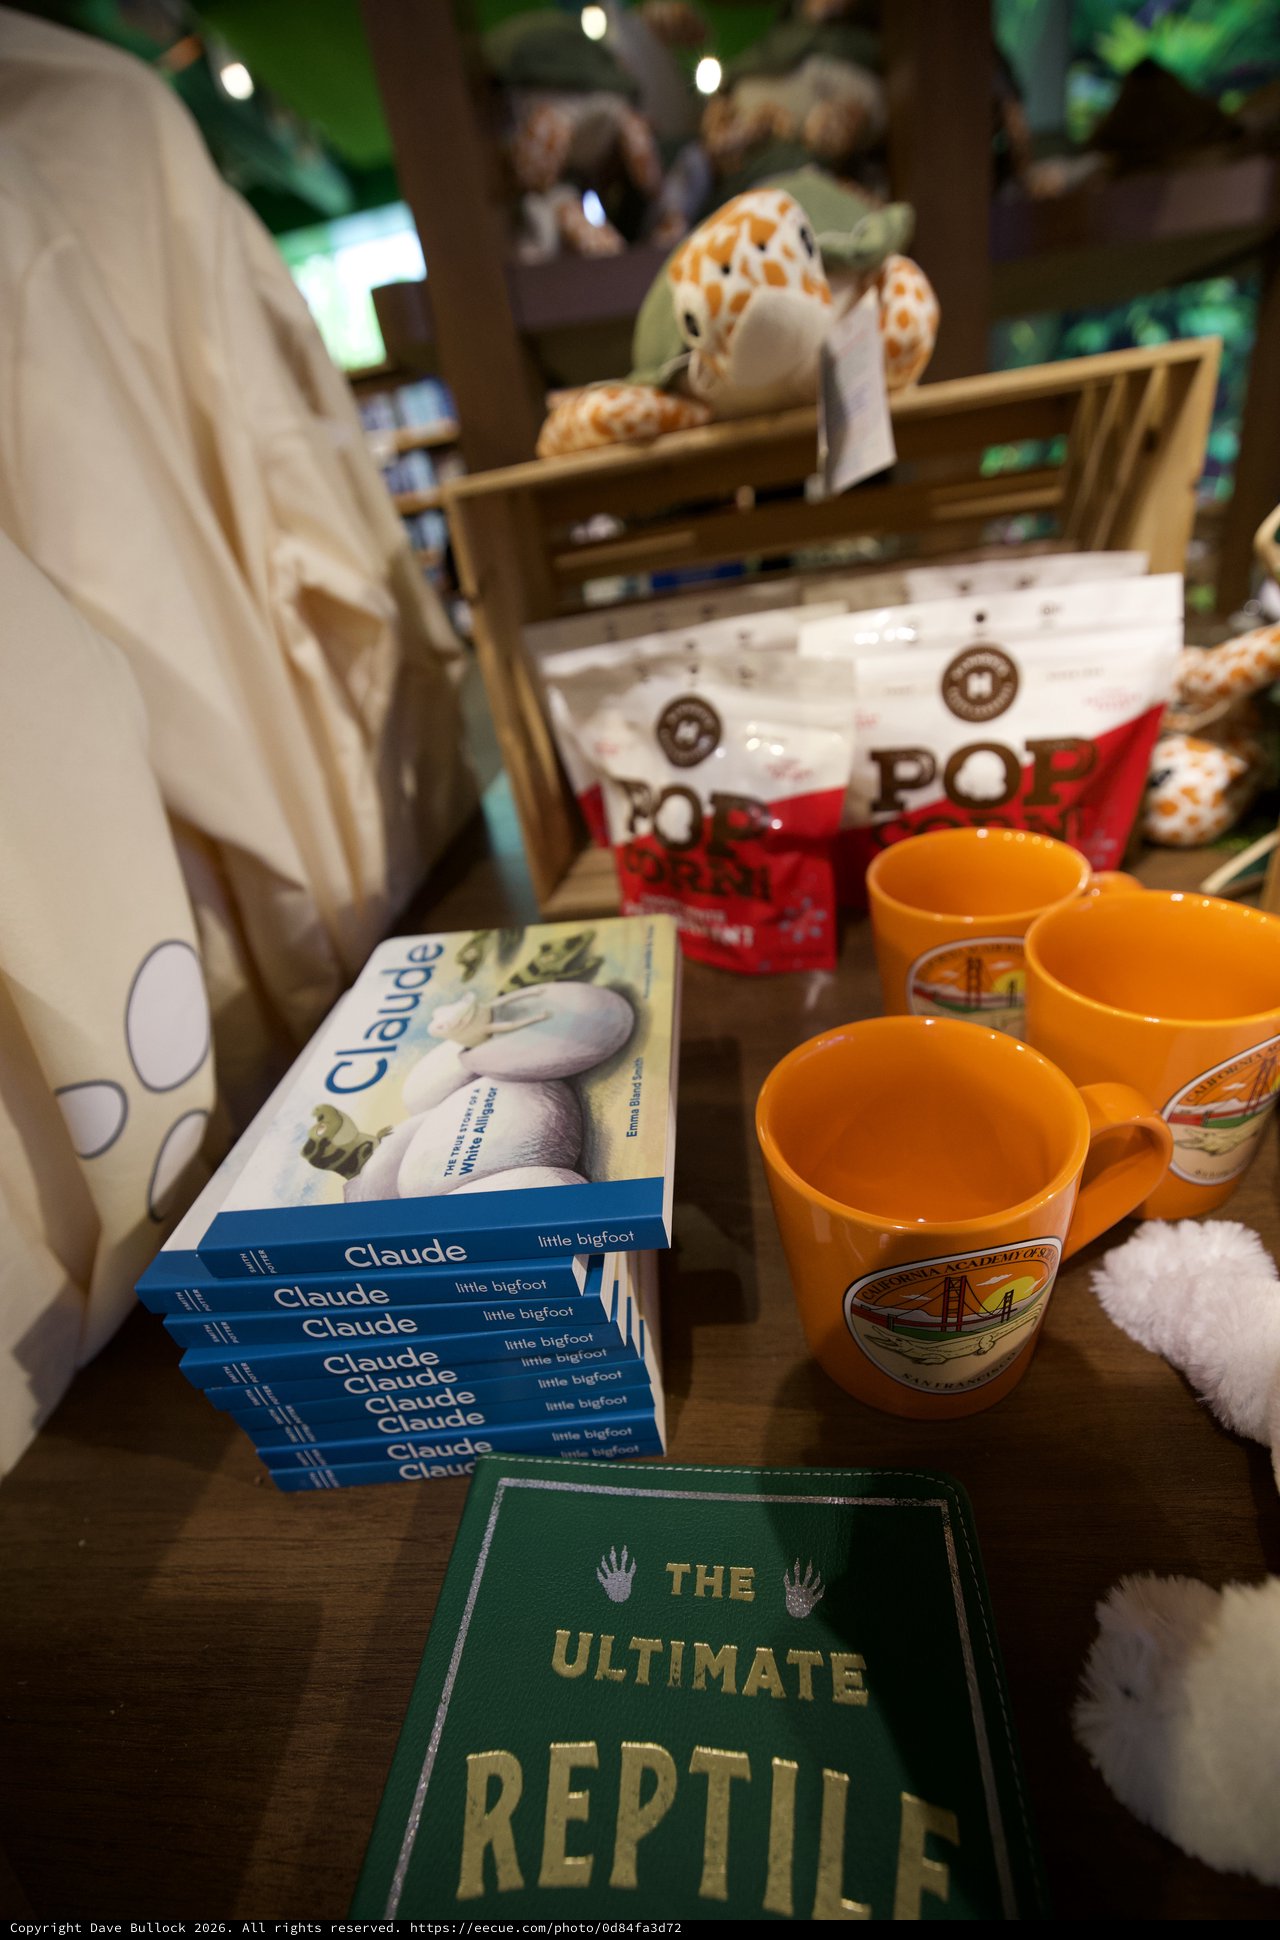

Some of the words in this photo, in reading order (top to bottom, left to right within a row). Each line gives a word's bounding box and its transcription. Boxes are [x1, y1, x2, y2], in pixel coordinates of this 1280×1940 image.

[869, 737, 1099, 813] POP
[613, 776, 770, 858] POP
[325, 943, 445, 1094] Claude
[629, 1082, 642, 1107] Bland
[458, 1137, 483, 1176] White
[473, 1087, 498, 1134] Alligator
[459, 1107, 474, 1133] STORY
[626, 1108, 640, 1137] Emma
[450, 1135, 465, 1157] TRUE
[444, 1159, 457, 1177] THE
[538, 1235, 572, 1248] little
[577, 1230, 635, 1248] bigfoot
[240, 1253, 257, 1274] SMITH
[258, 1249, 278, 1274] POTTER
[344, 1238, 468, 1268] Claude
[455, 1281, 488, 1294] little
[492, 1279, 548, 1295] bigfoot
[862, 1268, 941, 1300] CALIFORNIA
[944, 1250, 1024, 1273] ACADEMY
[1022, 1249, 1037, 1259] OF
[273, 1282, 390, 1308] Claude
[302, 1312, 418, 1339] Claude
[483, 1309, 516, 1321] little
[519, 1306, 575, 1322] bigfoot
[504, 1338, 537, 1351] little
[540, 1332, 594, 1349] bigfoot
[323, 1347, 440, 1375] Claude
[520, 1356, 552, 1367] little
[556, 1348, 607, 1364] bigfoot
[344, 1367, 458, 1394] Claude
[538, 1377, 569, 1389] little
[571, 1370, 623, 1386] bigfoot
[903, 1372, 930, 1387] SAN
[365, 1388, 477, 1414] Claude
[545, 1400, 575, 1412] little
[578, 1395, 628, 1410] bigfoot
[377, 1408, 486, 1434] Claude
[551, 1430, 581, 1441] little
[584, 1427, 633, 1441] bigfoot
[387, 1437, 493, 1460] Claude
[399, 1461, 475, 1480] Clau
[666, 1562, 756, 1602] THE
[551, 1629, 869, 1706] ULTIMATE
